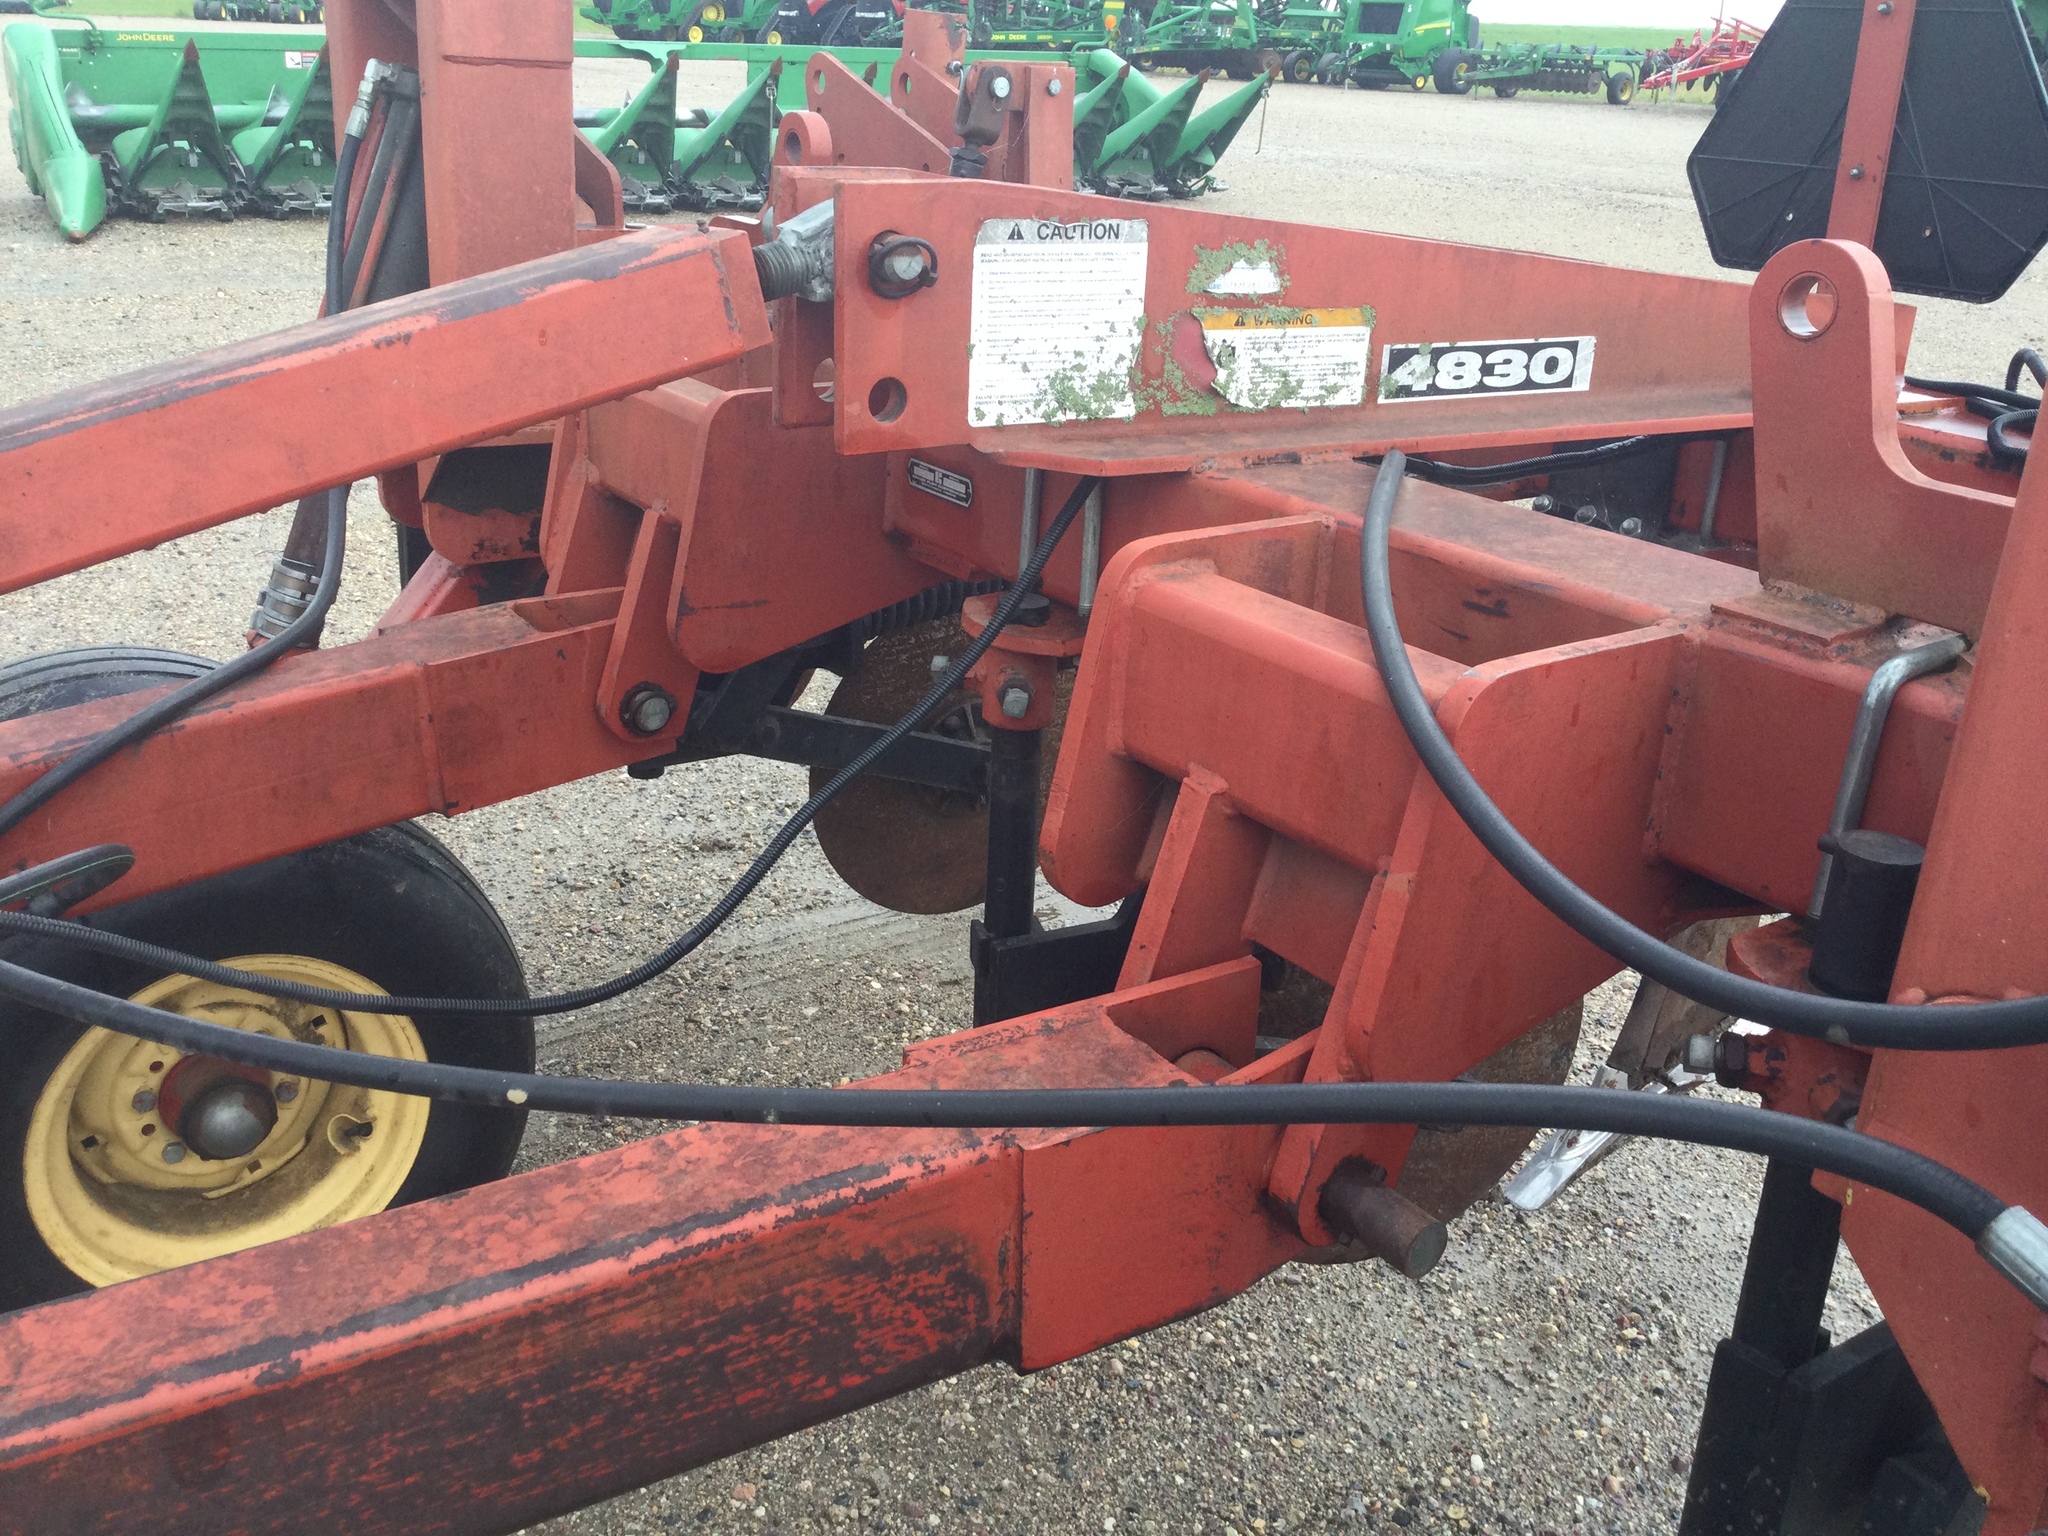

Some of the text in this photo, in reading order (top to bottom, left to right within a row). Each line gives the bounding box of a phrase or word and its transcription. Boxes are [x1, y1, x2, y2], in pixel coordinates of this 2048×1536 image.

[116, 33, 175, 42] JOHN DEERE
[1037, 223, 1120, 240] CAUTION
[1387, 346, 1574, 392] 4830
